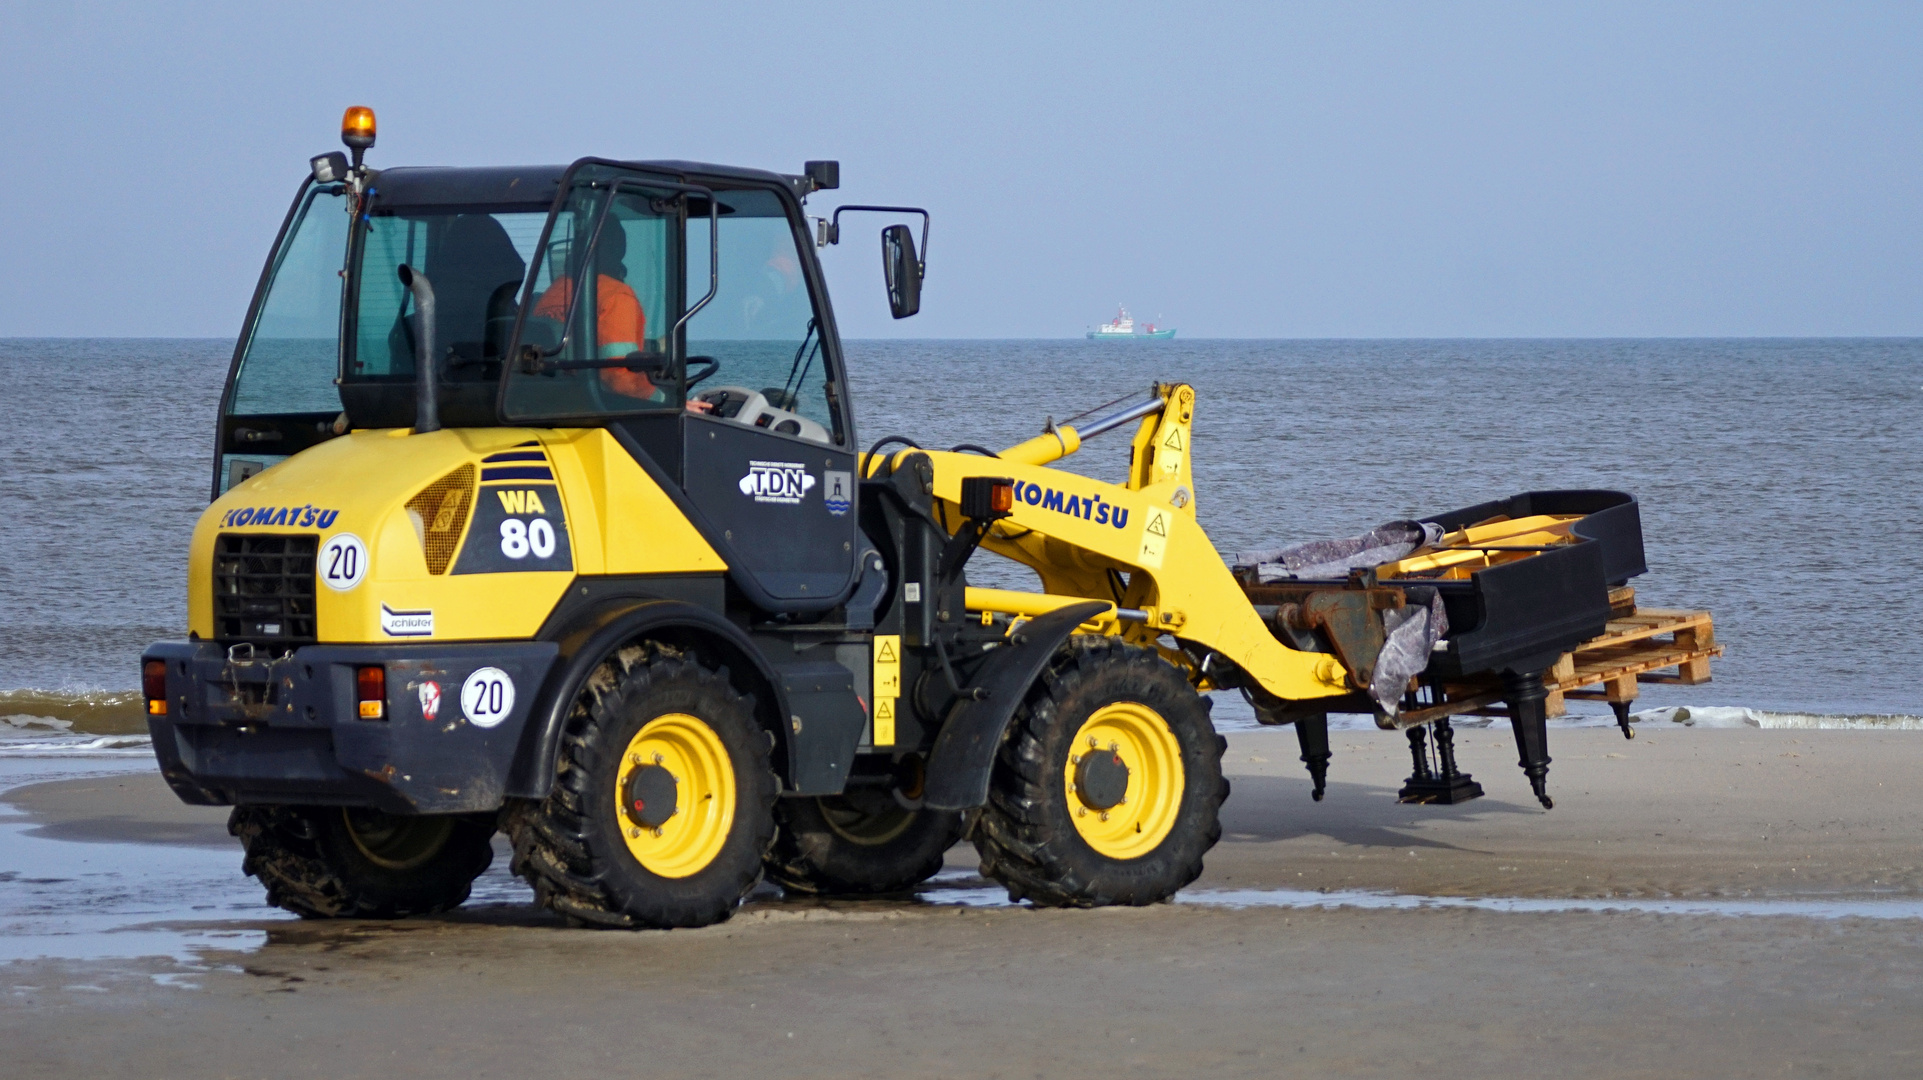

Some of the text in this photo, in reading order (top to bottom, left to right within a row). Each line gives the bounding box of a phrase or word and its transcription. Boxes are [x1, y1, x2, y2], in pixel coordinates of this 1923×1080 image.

[750, 468, 804, 498] TDN
[219, 504, 340, 529] KOMATSU
[497, 490, 546, 514] WA
[500, 518, 556, 559] 80
[328, 544, 357, 580] 20
[473, 680, 503, 715] 20
